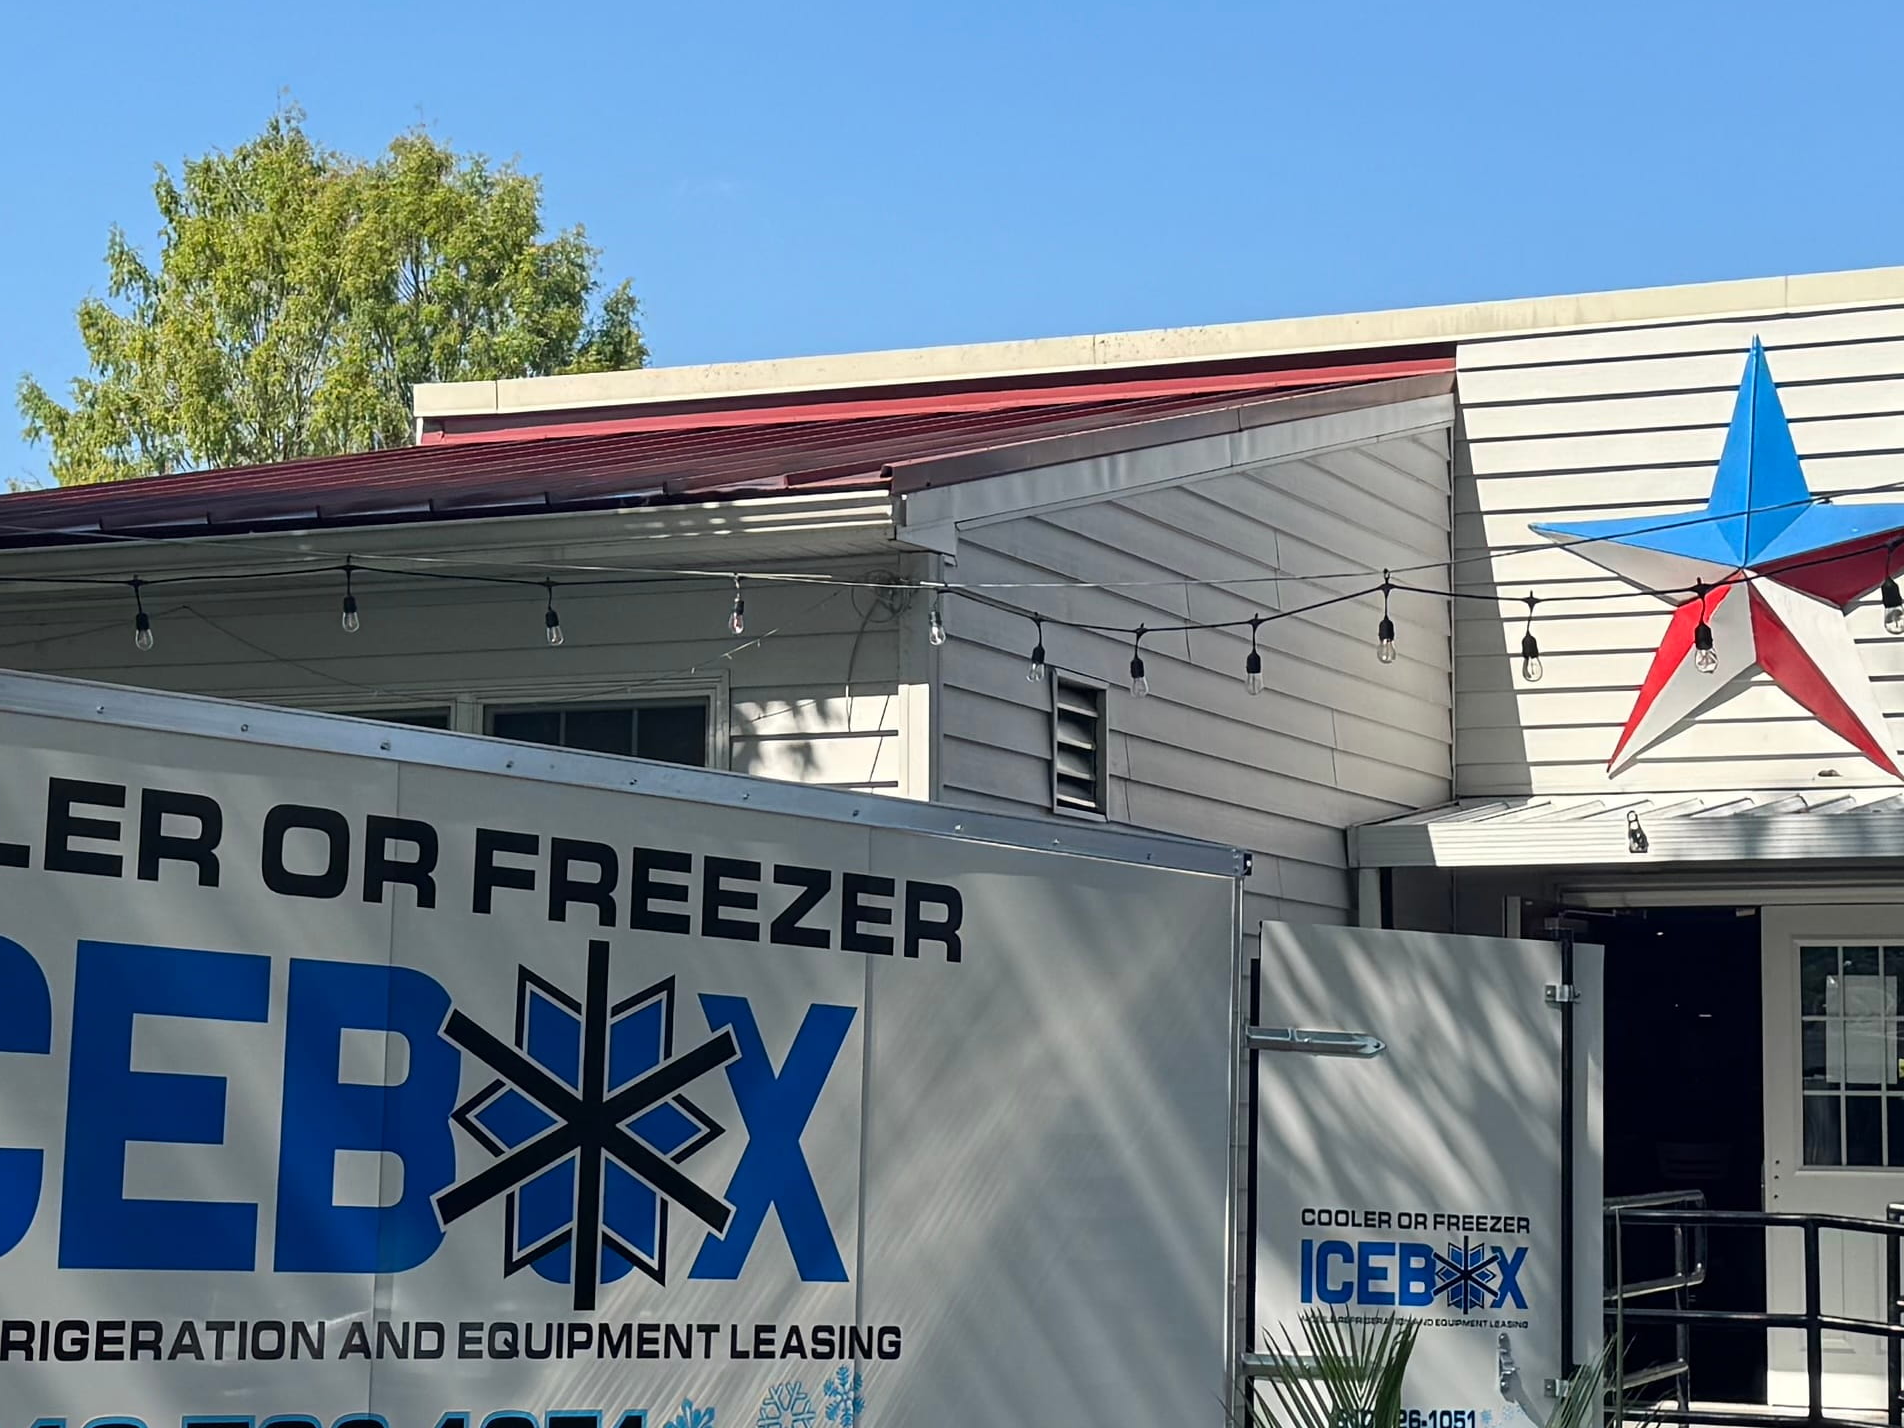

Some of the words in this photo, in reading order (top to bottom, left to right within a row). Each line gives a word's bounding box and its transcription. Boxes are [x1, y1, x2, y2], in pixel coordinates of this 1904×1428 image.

[260, 803, 440, 910] OR
[471, 827, 964, 964] FREEZER
[1301, 1208, 1392, 1229] COOLER
[1397, 1211, 1428, 1231] OR
[1433, 1213, 1530, 1234] FREEZER
[337, 1320, 446, 1360] AND
[456, 1322, 720, 1360] EQUIPMENT
[729, 1324, 903, 1361] LEASING
